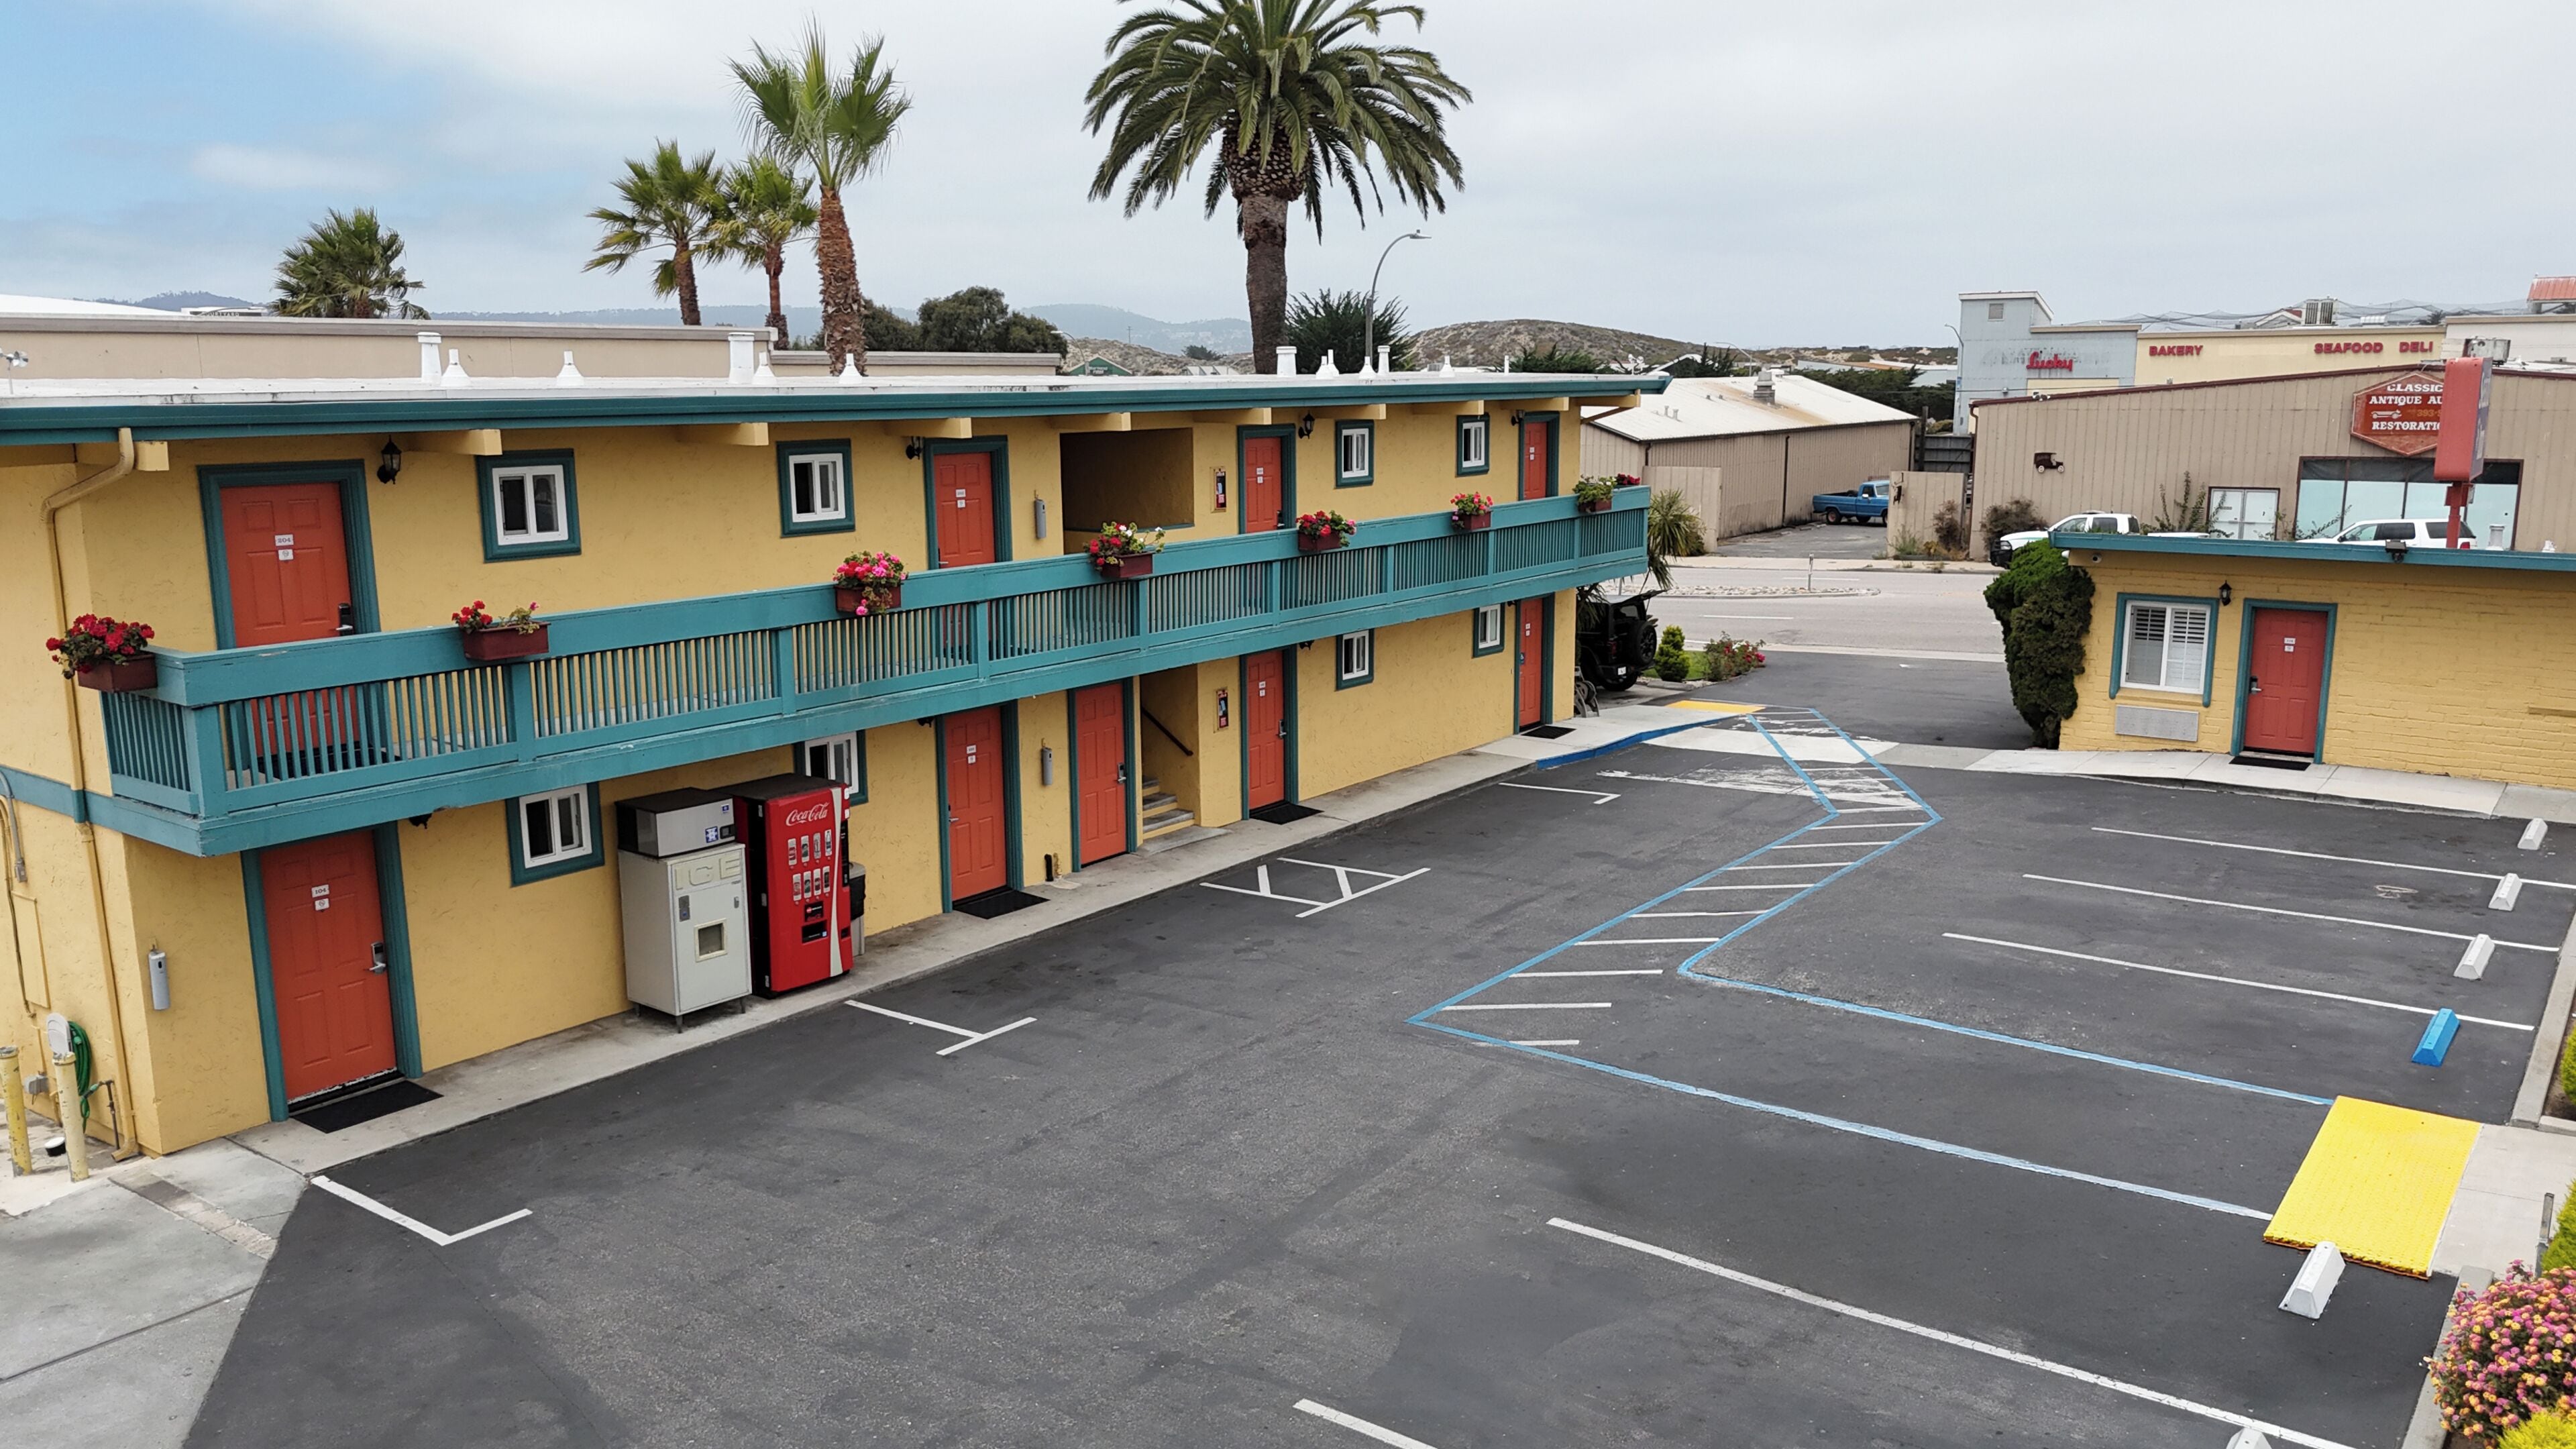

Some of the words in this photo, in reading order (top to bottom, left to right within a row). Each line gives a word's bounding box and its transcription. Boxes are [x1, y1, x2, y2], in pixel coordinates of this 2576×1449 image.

[2149, 345, 2204, 356] BAKERY
[2314, 342, 2383, 354] SEAFOOD
[2399, 341, 2433, 353] DELI
[2026, 351, 2073, 372] Lucky
[2387, 383, 2443, 392] CLASSIC
[2369, 396, 2422, 406] ANTIQUE
[674, 851, 741, 890] ICE
